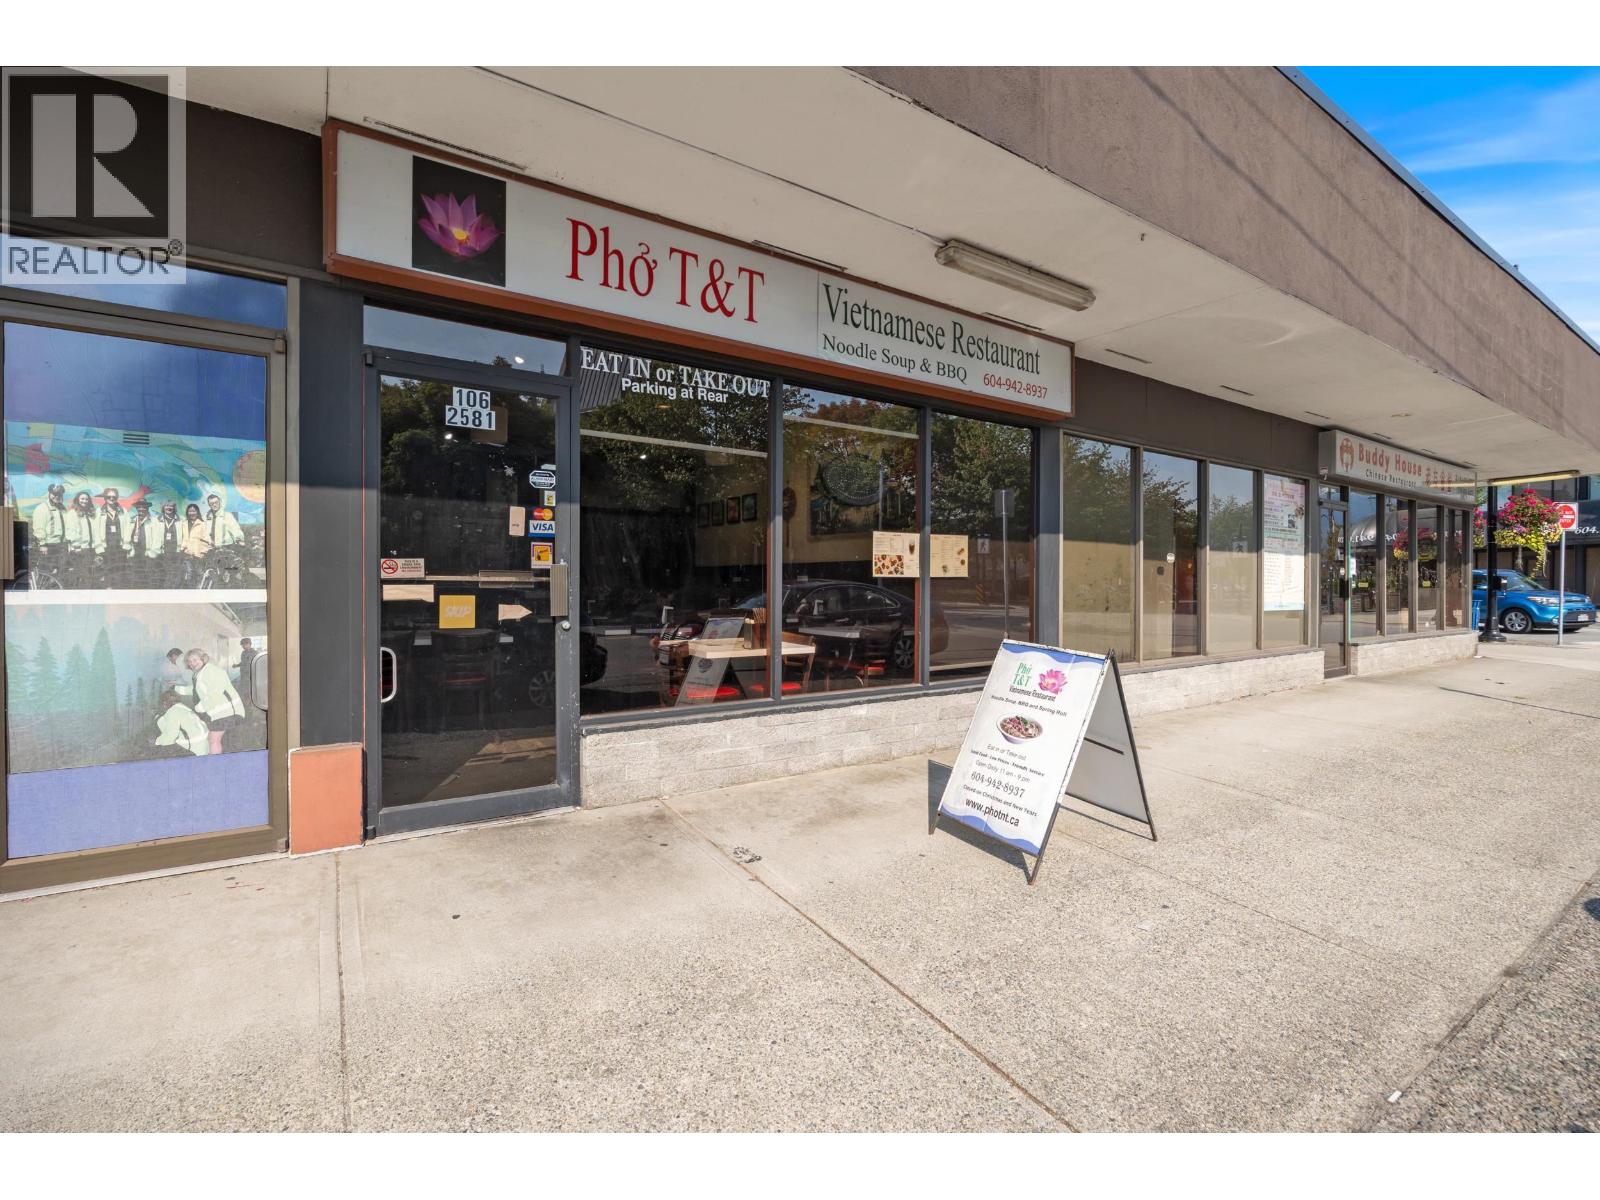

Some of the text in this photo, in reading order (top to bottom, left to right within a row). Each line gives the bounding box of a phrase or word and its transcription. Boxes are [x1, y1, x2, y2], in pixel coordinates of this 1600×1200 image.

[566, 217, 765, 323] Phở T&T
[822, 283, 1040, 375] Vietnamese Restaurant
[822, 333, 968, 385] Noodle Soup & BBQ
[580, 347, 771, 398] EAT IN or TAKE OUT
[621, 378, 728, 403] Parking at Rear
[983, 373, 1048, 399] 604-942-8937
[456, 389, 489, 409] 106
[447, 407, 492, 428] 2581
[1358, 442, 1422, 476] Buddy House
[1365, 468, 1387, 481] Chinese
[532, 522, 554, 532] VISA
[1013, 674, 1032, 687] T&T
[1009, 685, 1056, 702] Vietnamese Restaurant
[1039, 705, 1056, 716] Spring
[1006, 749, 1017, 758] Take
[987, 763, 999, 773] Daily
[970, 771, 1025, 798] 604-942-8937
[963, 784, 976, 793] Closed
[983, 791, 1003, 804] Christmas
[1013, 803, 1023, 811] New
[1024, 807, 1038, 817] Years
[965, 799, 1020, 827] www.photnt.ca
